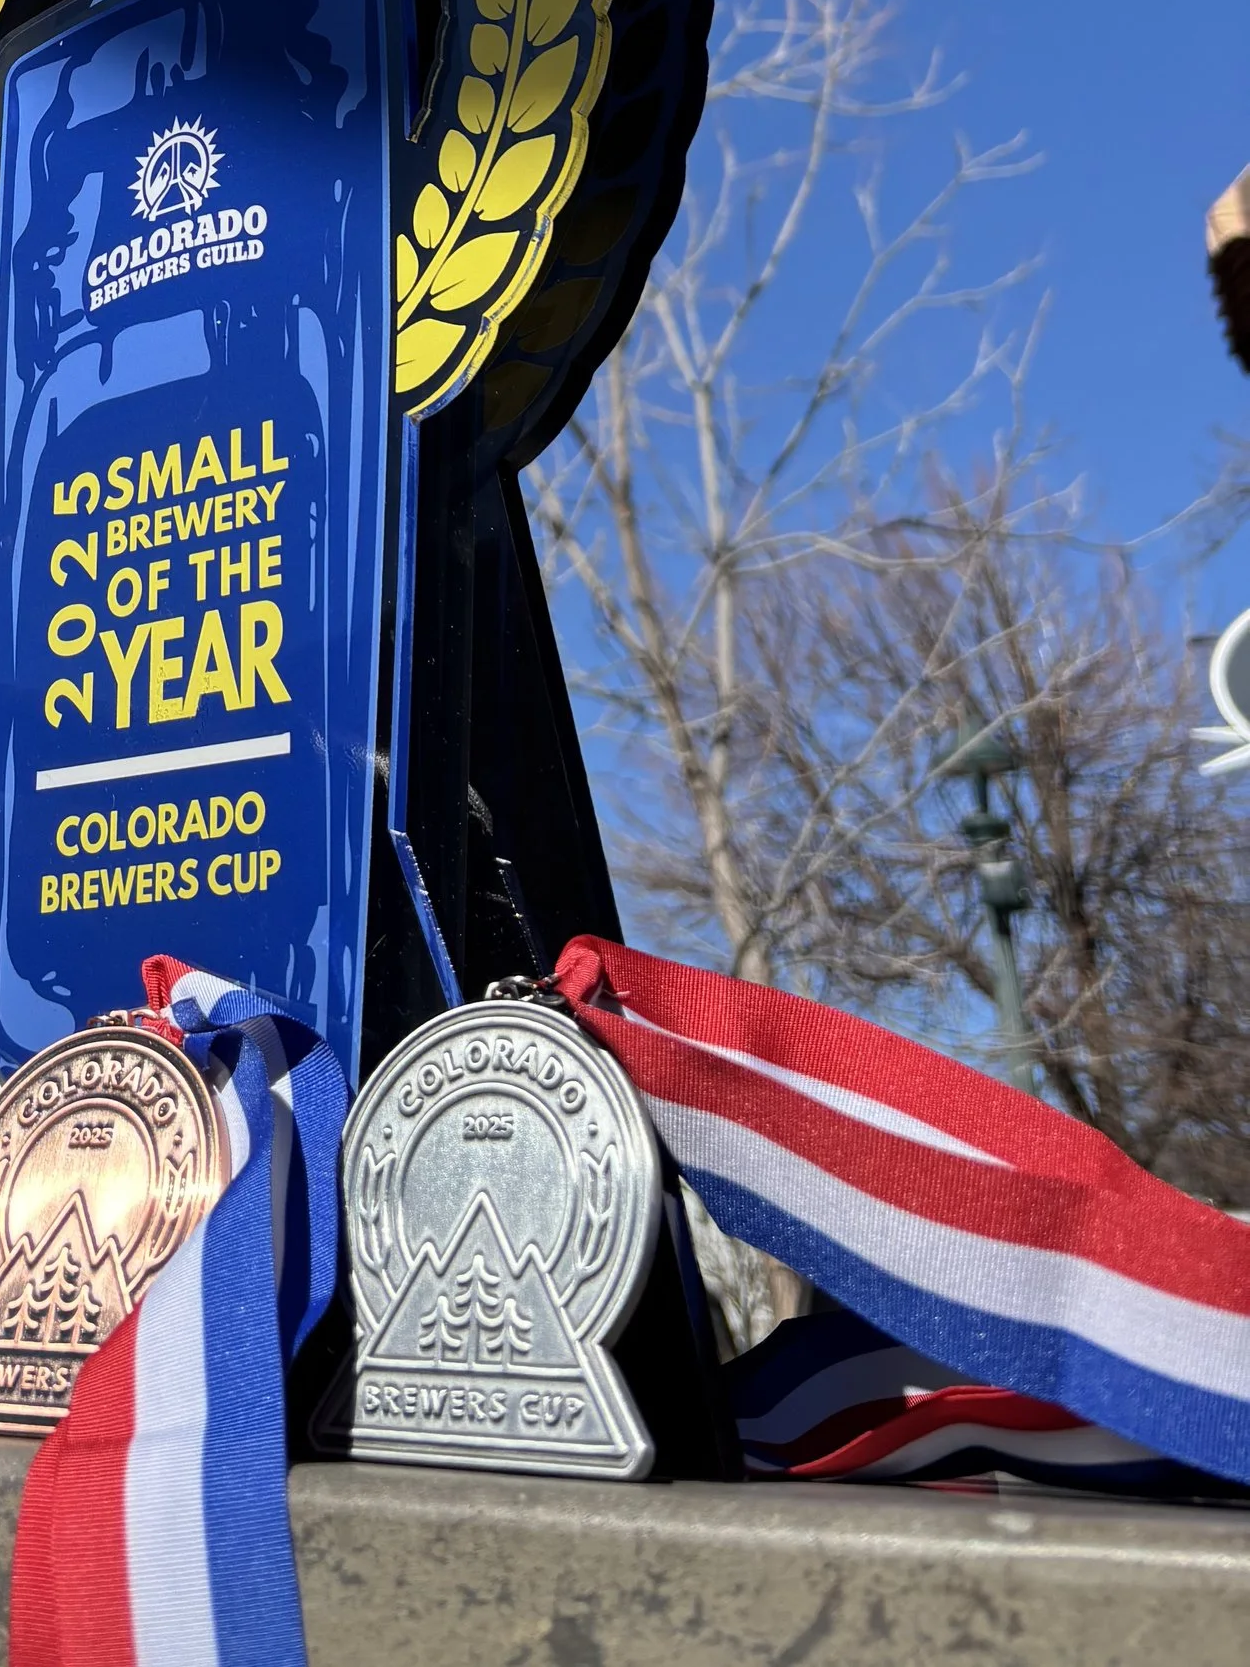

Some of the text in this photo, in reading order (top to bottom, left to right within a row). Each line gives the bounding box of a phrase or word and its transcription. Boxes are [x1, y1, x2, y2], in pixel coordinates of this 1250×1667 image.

[87, 204, 268, 287] COLORADO
[89, 238, 265, 312] BREWERS GUILD
[103, 419, 290, 511] SMALL
[106, 480, 286, 558] BREWERY
[44, 471, 101, 729] 2025
[106, 534, 283, 618] OF THE
[99, 599, 292, 730] YEAR
[55, 790, 267, 857] COLORADO
[40, 848, 282, 914] BREWERS CUP
[18, 1059, 178, 1128] COLORADO
[398, 1037, 587, 1117] COLORADO
[68, 1124, 115, 1151] 2025
[462, 1115, 515, 1140] 2025
[363, 1384, 587, 1428] BREWERS CUP
